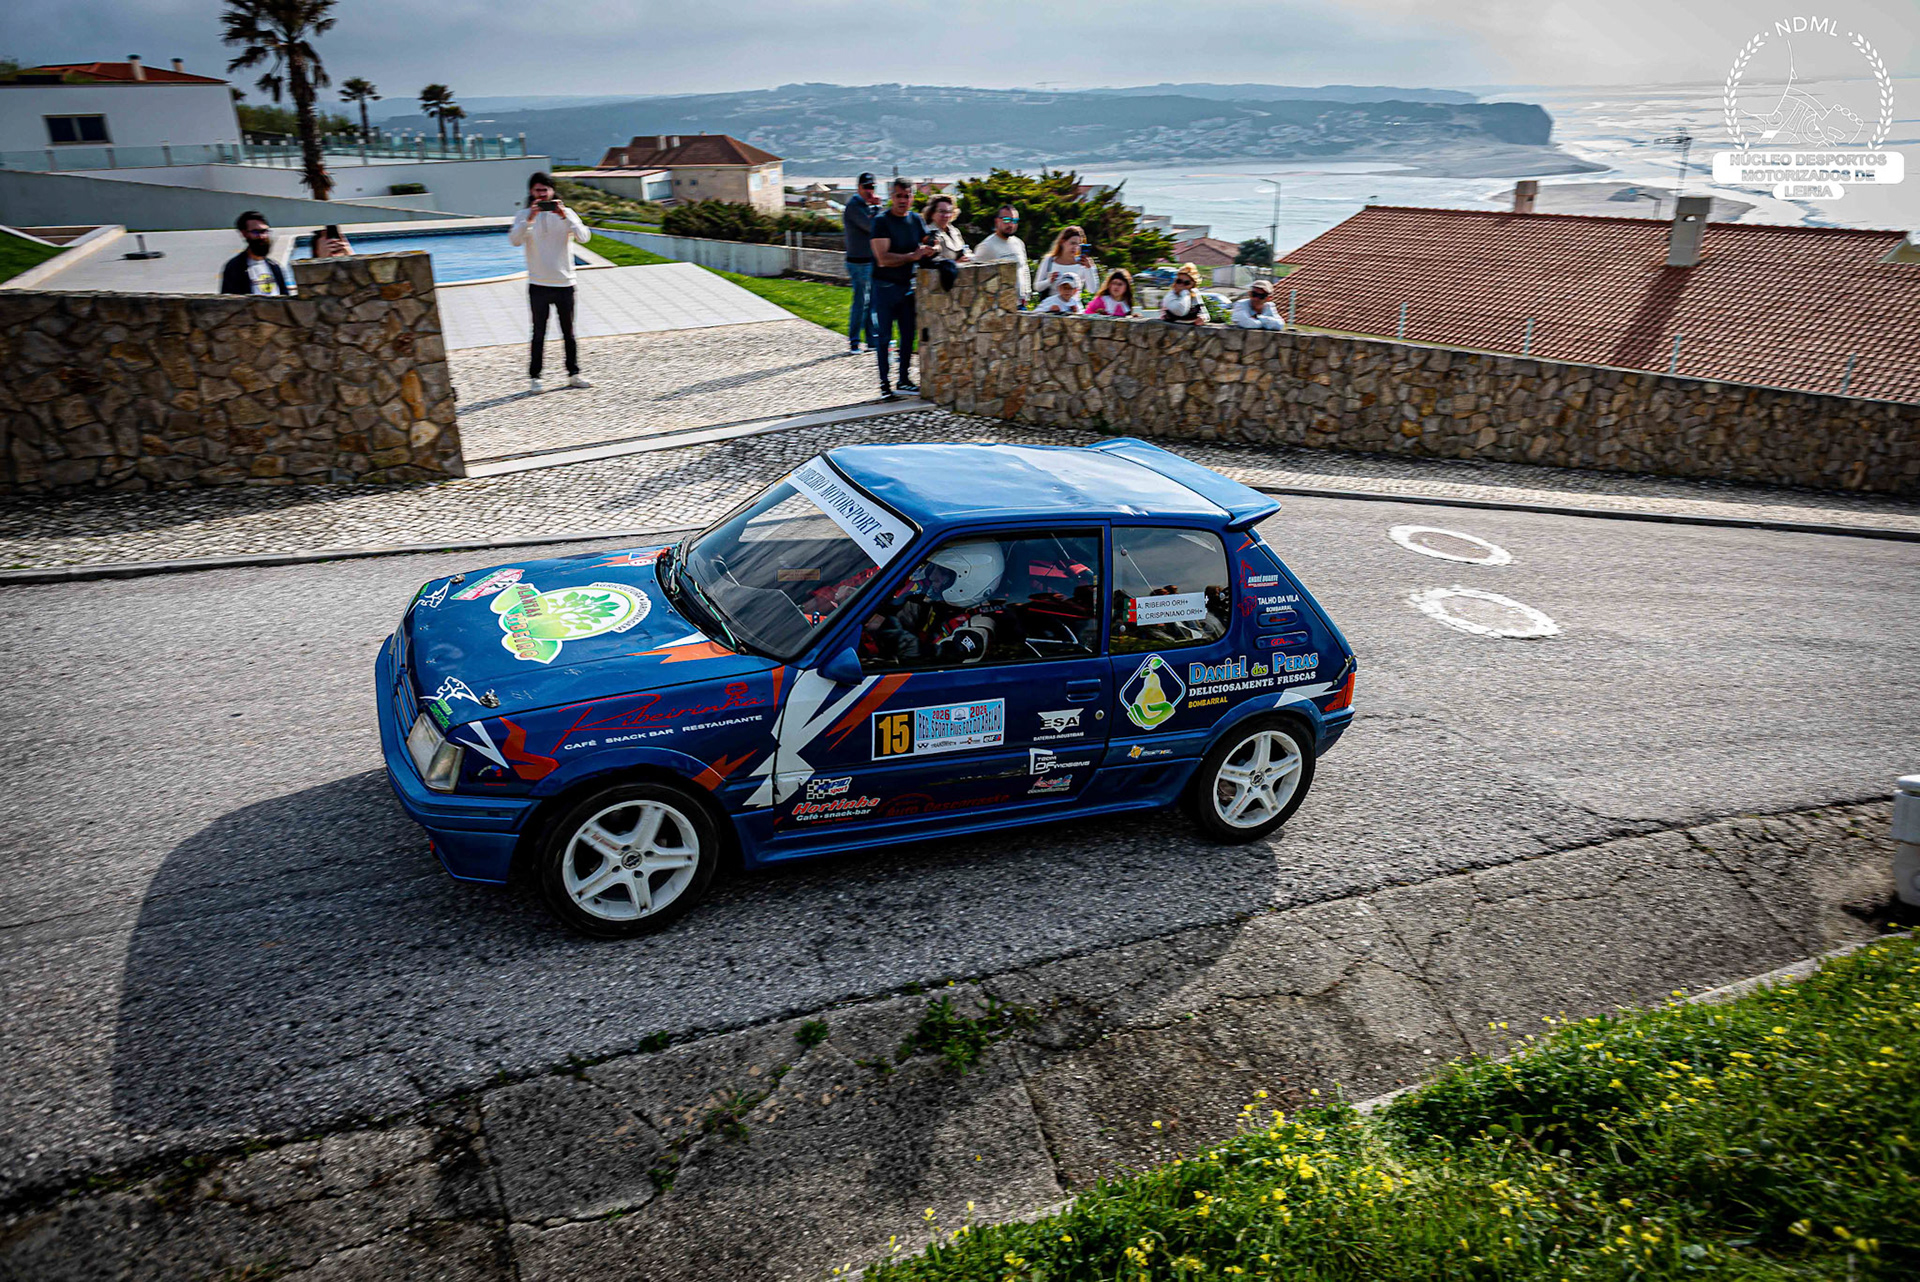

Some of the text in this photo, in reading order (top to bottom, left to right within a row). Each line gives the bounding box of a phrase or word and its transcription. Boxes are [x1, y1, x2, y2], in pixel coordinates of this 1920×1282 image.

[818, 483, 882, 535] MOTORSPORT
[516, 584, 542, 617] PLANTAS
[1145, 600, 1170, 608] RIBEIRO
[1257, 594, 1300, 605] TALHO DA VILA
[1145, 609, 1185, 619] CRISPINIANO
[505, 612, 539, 658] RIBEIRO
[1251, 662, 1269, 676] das
[1188, 671, 1317, 697] DELICIOSAMENTE FRESCAS
[1187, 696, 1228, 709] BOMBARRAL
[1040, 716, 1079, 728] ESA
[564, 715, 763, 750] CAFÉ SNACK BAR RESTAURANTE
[878, 714, 910, 755] 15
[792, 797, 880, 815] Hortinha
[796, 813, 818, 822] Café
[823, 809, 871, 819] snack-bar
